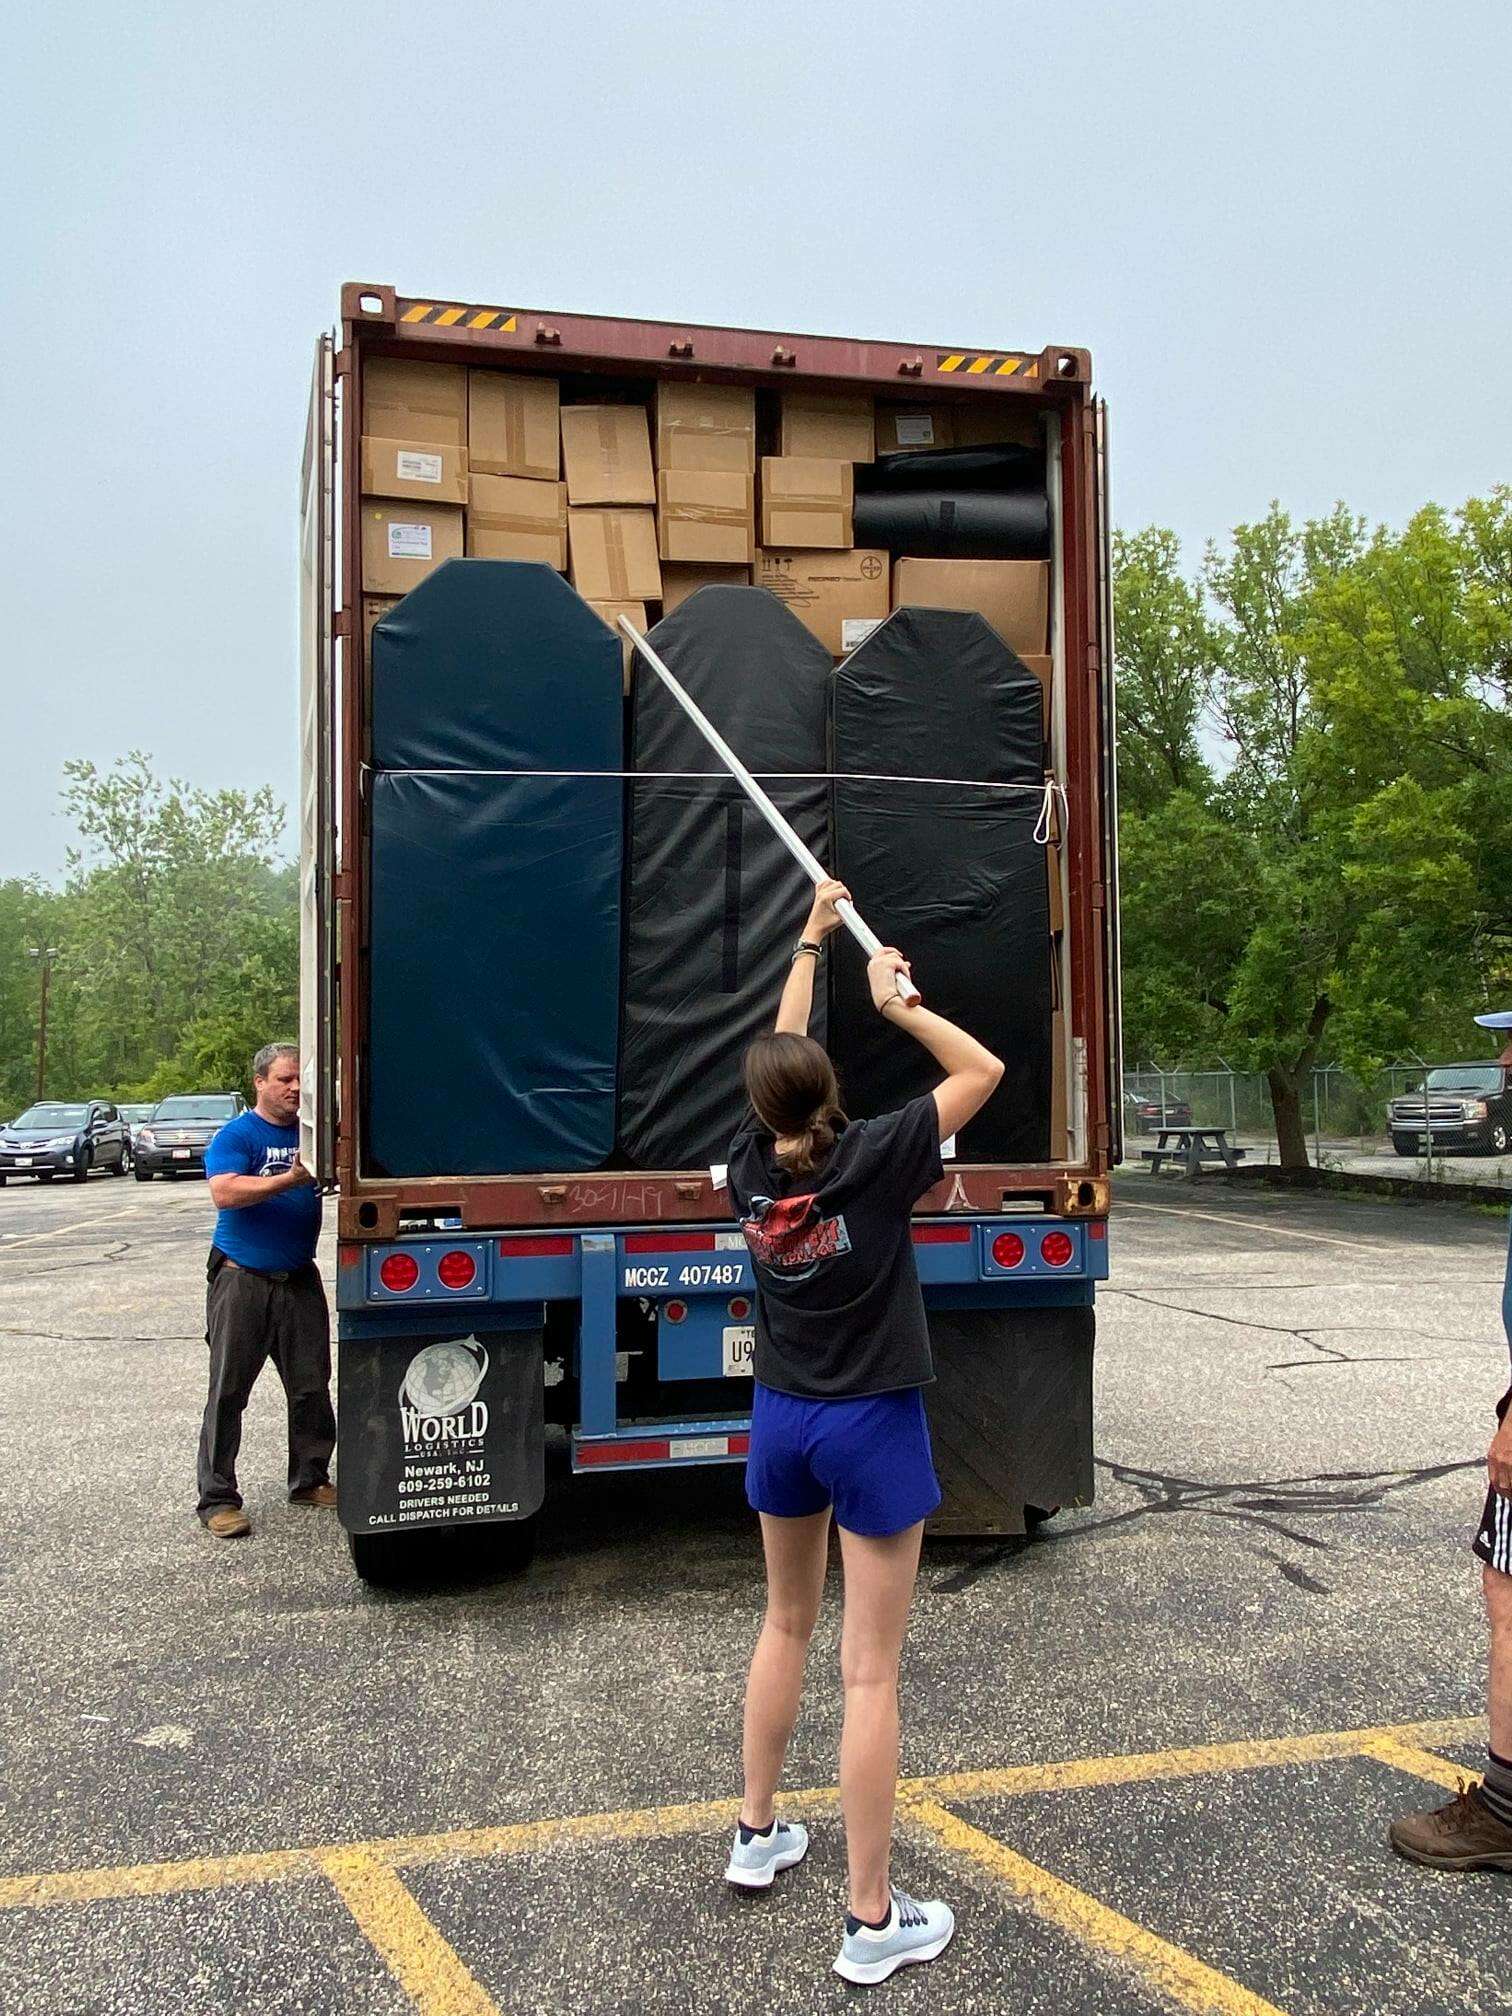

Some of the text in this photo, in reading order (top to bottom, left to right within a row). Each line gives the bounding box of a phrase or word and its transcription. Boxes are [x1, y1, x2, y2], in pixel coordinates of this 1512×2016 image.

[625, 1264, 743, 1288] MCCZ 407487
[400, 1400, 488, 1443] WORLD
[404, 1438, 484, 1453] LOGISTICS
[404, 1459, 484, 1478] Newark, NJ
[398, 1474, 490, 1493] 609-259-6102
[399, 1492, 489, 1509] DRIVERS NEEDED
[368, 1513, 396, 1525] CALL
[399, 1508, 450, 1522] DISPATCH
[452, 1506, 474, 1517] FOR
